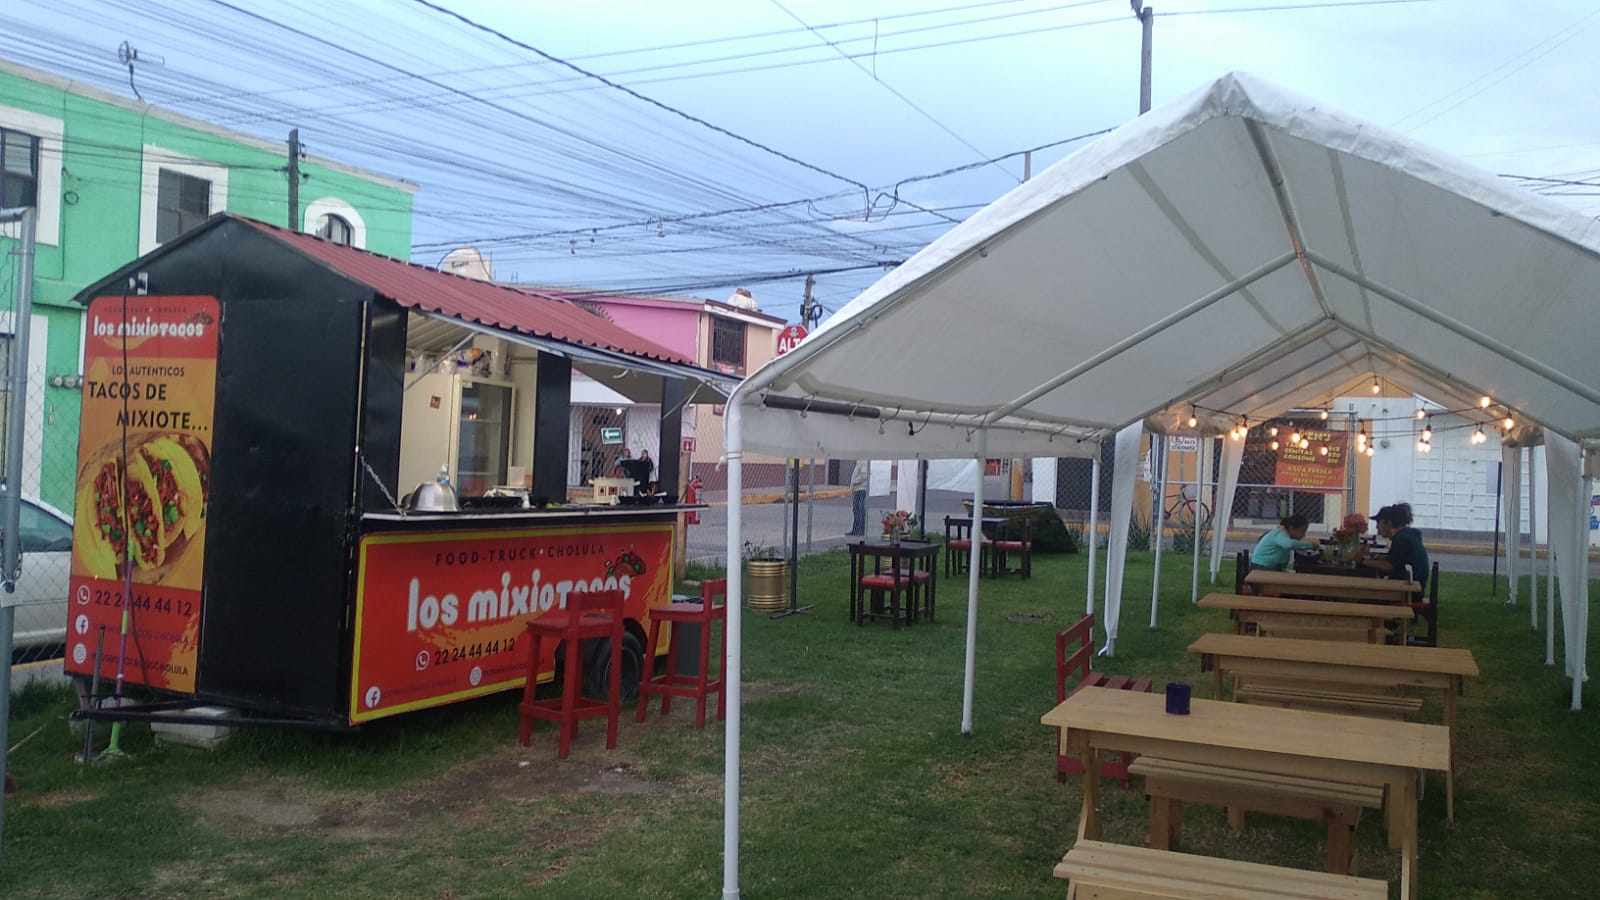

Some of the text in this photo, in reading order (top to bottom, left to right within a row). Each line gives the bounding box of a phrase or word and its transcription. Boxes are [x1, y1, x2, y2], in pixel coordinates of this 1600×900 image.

[94, 316, 114, 336] los
[779, 337, 803, 353] ALT
[129, 366, 184, 377] AUTENTICOS
[88, 381, 167, 401] TACOS DE
[116, 410, 208, 431] MIXIOTE...
[548, 544, 604, 558] CHOLULA
[95, 590, 110, 606] 22
[134, 595, 151, 610] 44
[155, 597, 171, 613] 44
[177, 600, 192, 617] 12
[407, 576, 459, 632] los
[435, 637, 515, 665] 22 24 44 44 12
